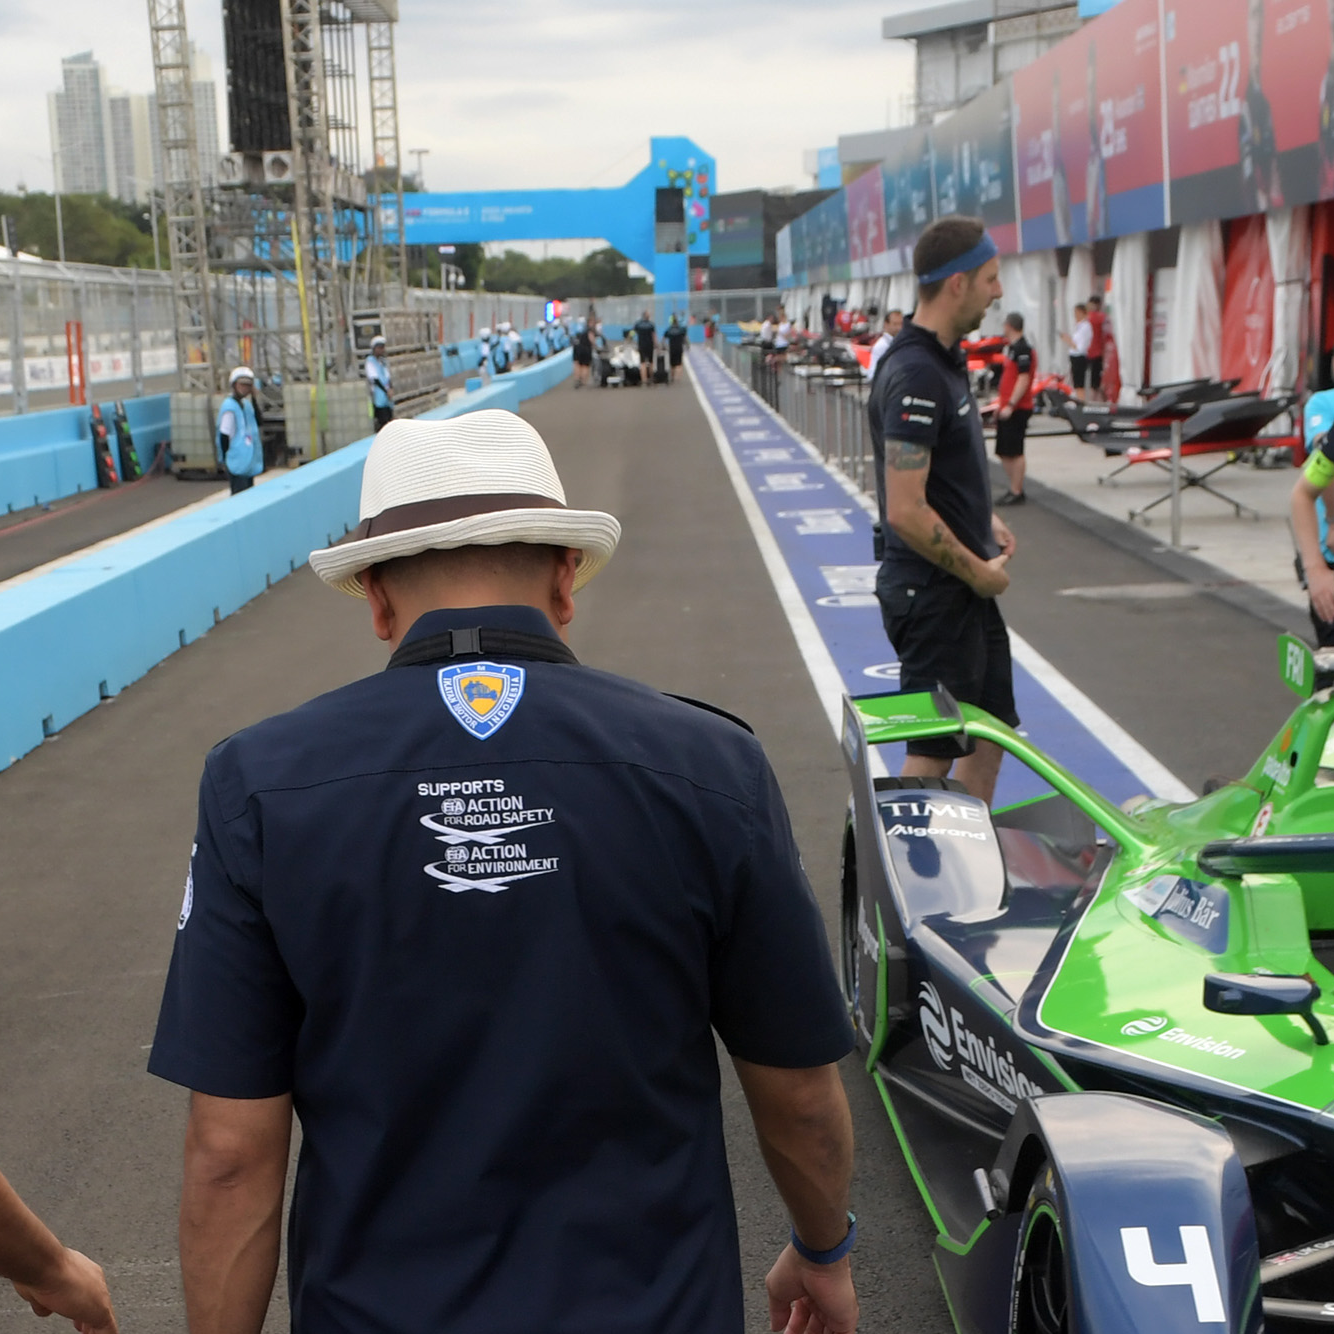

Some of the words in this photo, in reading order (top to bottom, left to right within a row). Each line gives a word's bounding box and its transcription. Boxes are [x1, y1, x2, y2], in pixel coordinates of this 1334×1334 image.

[1285, 641, 1305, 687] FRI
[443, 678, 457, 704] IKATAN
[453, 702, 478, 729] MOTOR
[487, 676, 520, 727] INDONESIA
[418, 779, 505, 796] SUPPORTS
[467, 796, 524, 813] ACTION
[880, 802, 983, 823] TIME
[444, 816, 463, 826] FOR
[464, 813, 500, 826] ROAD
[502, 808, 554, 824] SAFETY
[887, 823, 987, 841] Algorand
[471, 843, 527, 861] ACTION
[448, 864, 467, 873] FOR
[468, 858, 559, 875] ENVIRONMENT
[1190, 896, 1220, 930] Bär
[1158, 1027, 1246, 1059] Envision
[1120, 1225, 1226, 1322] 4
